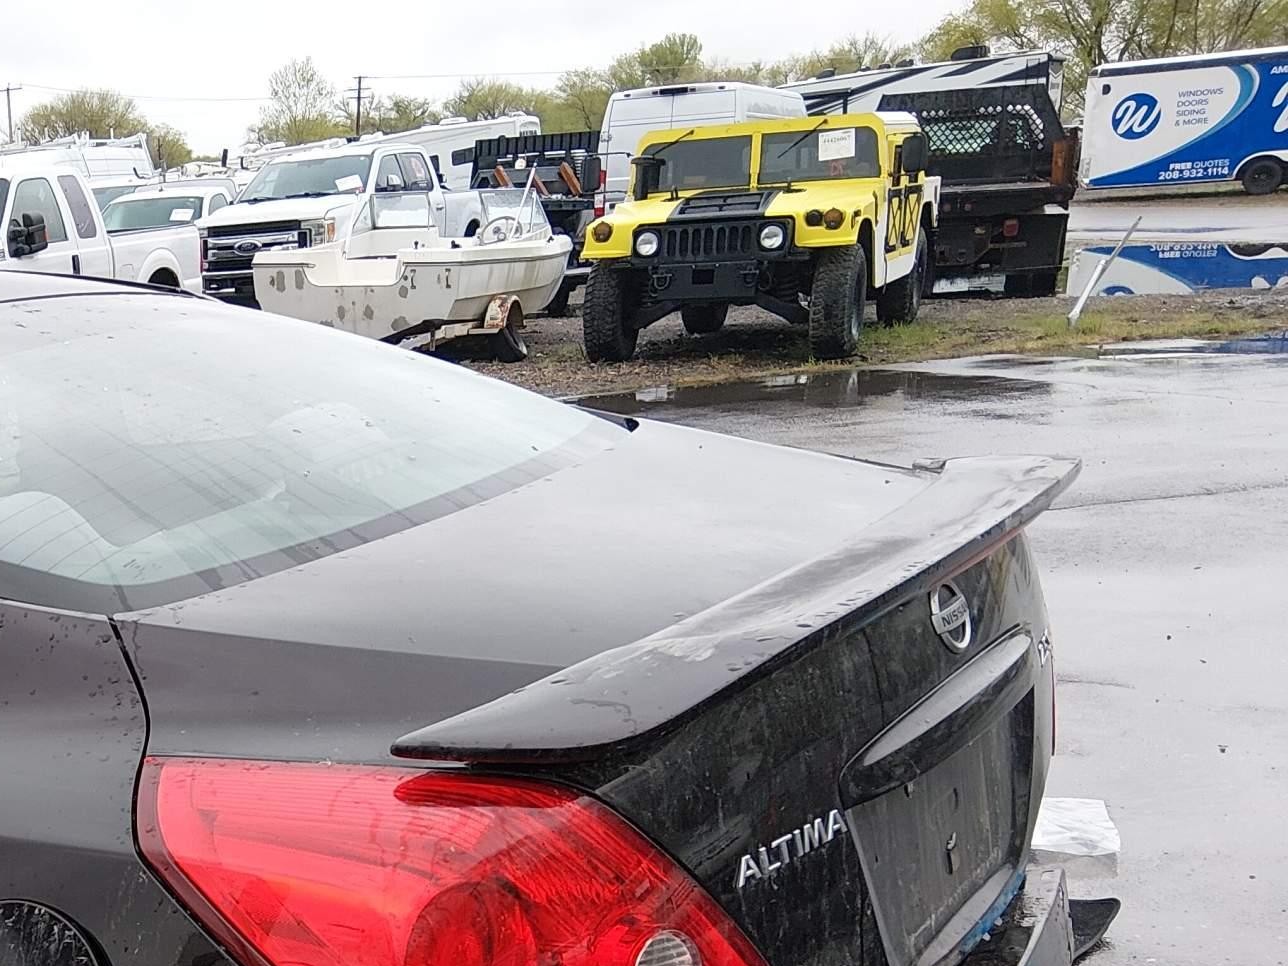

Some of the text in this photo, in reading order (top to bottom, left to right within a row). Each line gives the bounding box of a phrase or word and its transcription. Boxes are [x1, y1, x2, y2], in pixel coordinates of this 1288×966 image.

[1178, 87, 1223, 98] WINDOWS
[1176, 98, 1209, 108] DOORS
[1115, 100, 1160, 135] W
[1175, 108, 1206, 118] SIDING
[1174, 117, 1209, 127] & MORE
[1169, 158, 1230, 171] FREE QUOTES
[1158, 166, 1229, 180] 208-932-1114
[736, 809, 849, 888] ALTIMA
